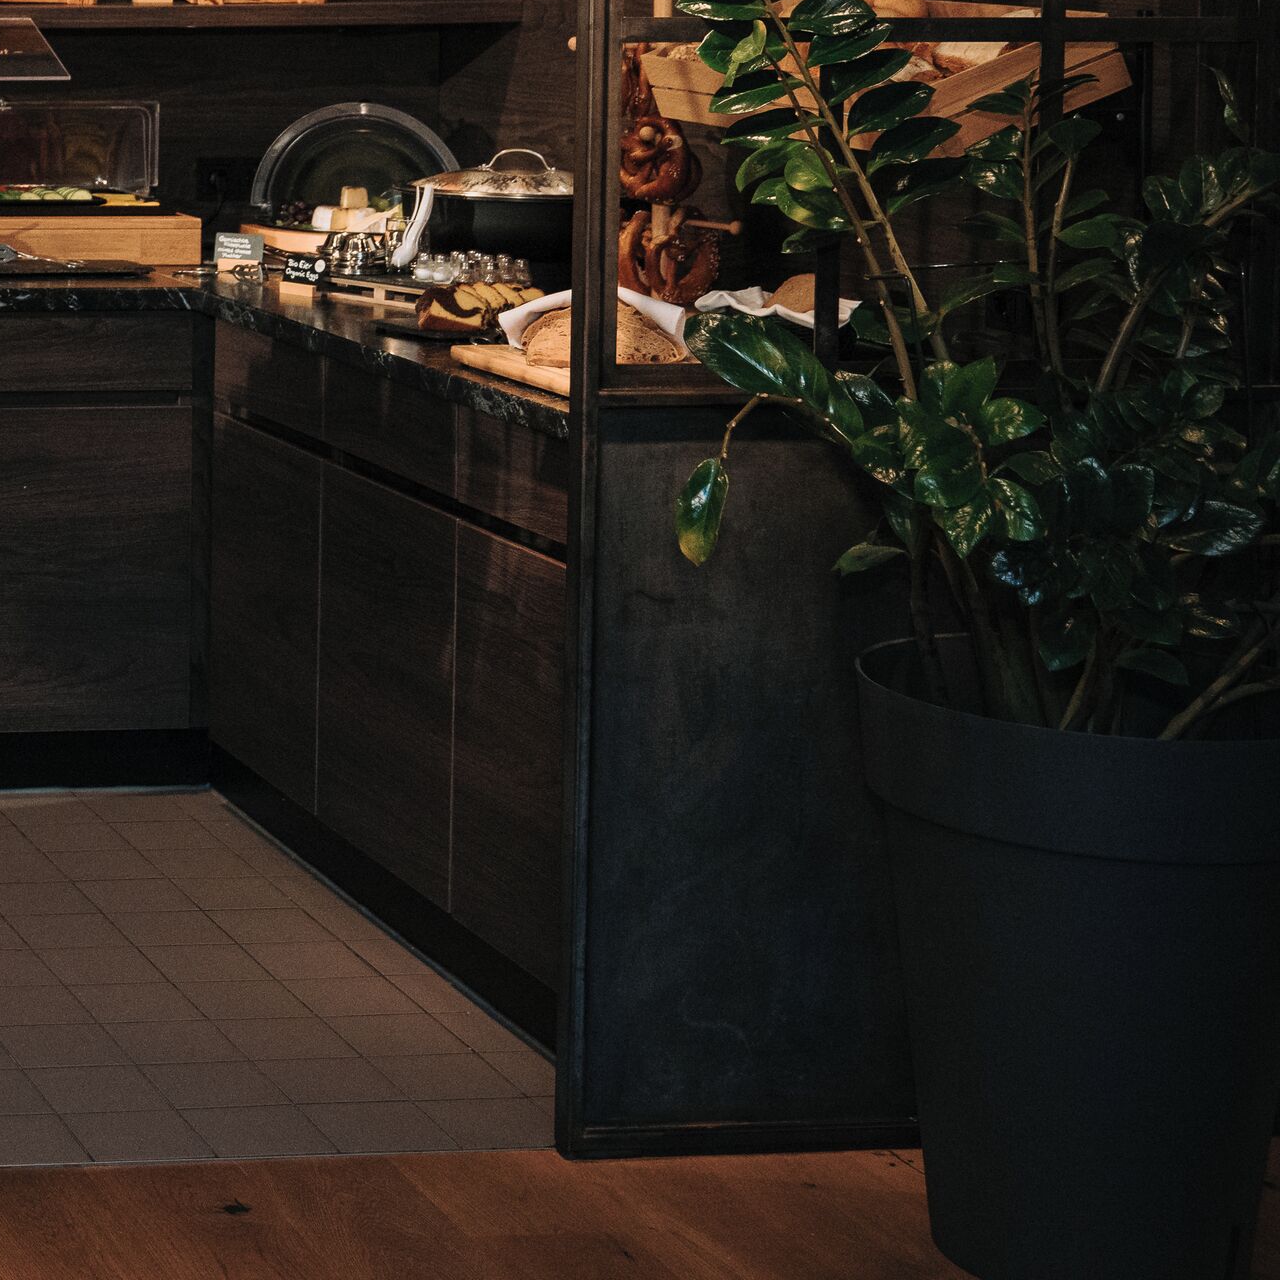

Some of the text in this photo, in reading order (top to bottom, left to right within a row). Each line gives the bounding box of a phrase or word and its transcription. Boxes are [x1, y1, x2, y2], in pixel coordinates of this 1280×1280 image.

[288, 258, 313, 270] Bio Eier
[285, 267, 319, 282] Organic Eggs
